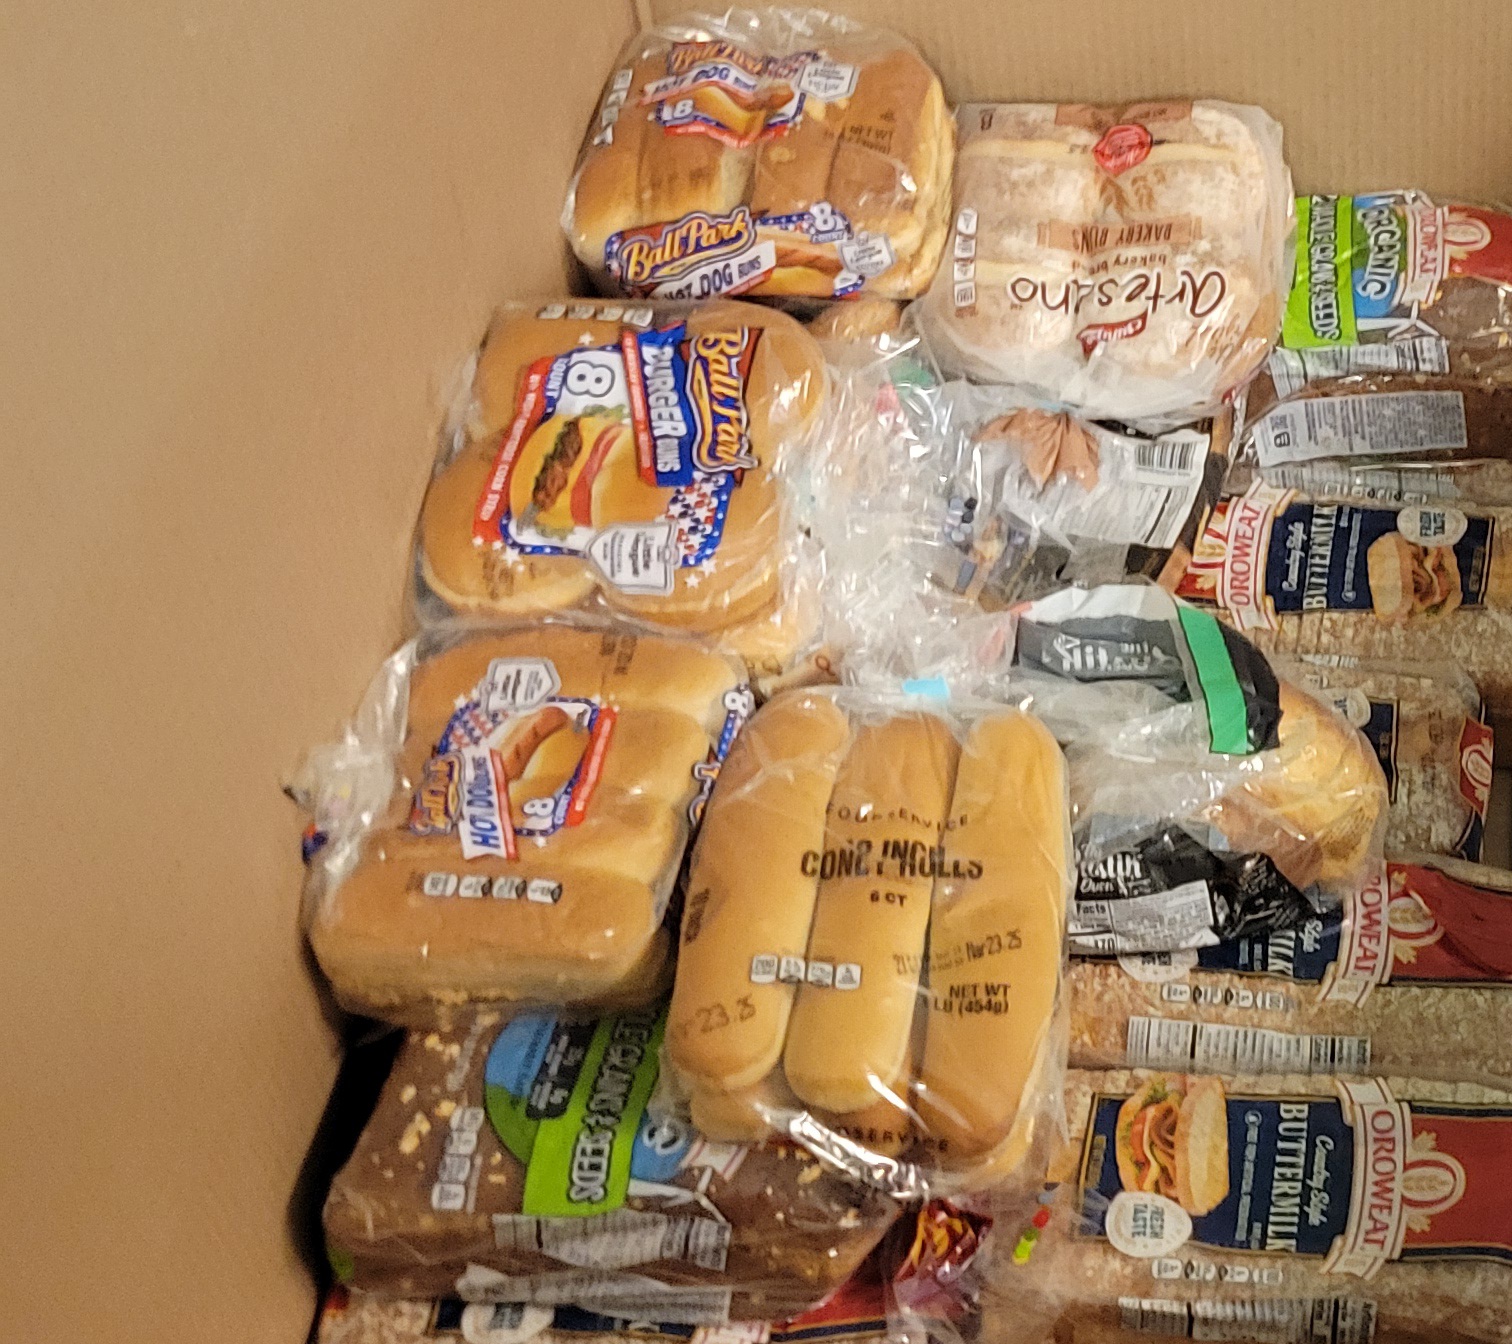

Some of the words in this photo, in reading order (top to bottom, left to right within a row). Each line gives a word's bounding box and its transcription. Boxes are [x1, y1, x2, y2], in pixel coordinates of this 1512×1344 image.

[622, 230, 682, 280] Ball
[684, 212, 748, 253] Park
[809, 202, 832, 231] 8
[699, 264, 734, 297] DOG
[1357, 207, 1401, 299] ORGANIC
[566, 360, 616, 399] 8
[641, 344, 687, 438] BURGER
[697, 330, 743, 401] Ball
[1229, 502, 1264, 606] OROWEAT
[1303, 504, 1339, 609] BUTTERMILK
[725, 689, 750, 716] 8
[523, 797, 554, 818] 8
[985, 983, 1011, 1000] WT
[1265, 1102, 1310, 1253] BUTTERMILK
[1364, 1108, 1397, 1248] OROWEAT
[1132, 1202, 1148, 1239] TASTE
